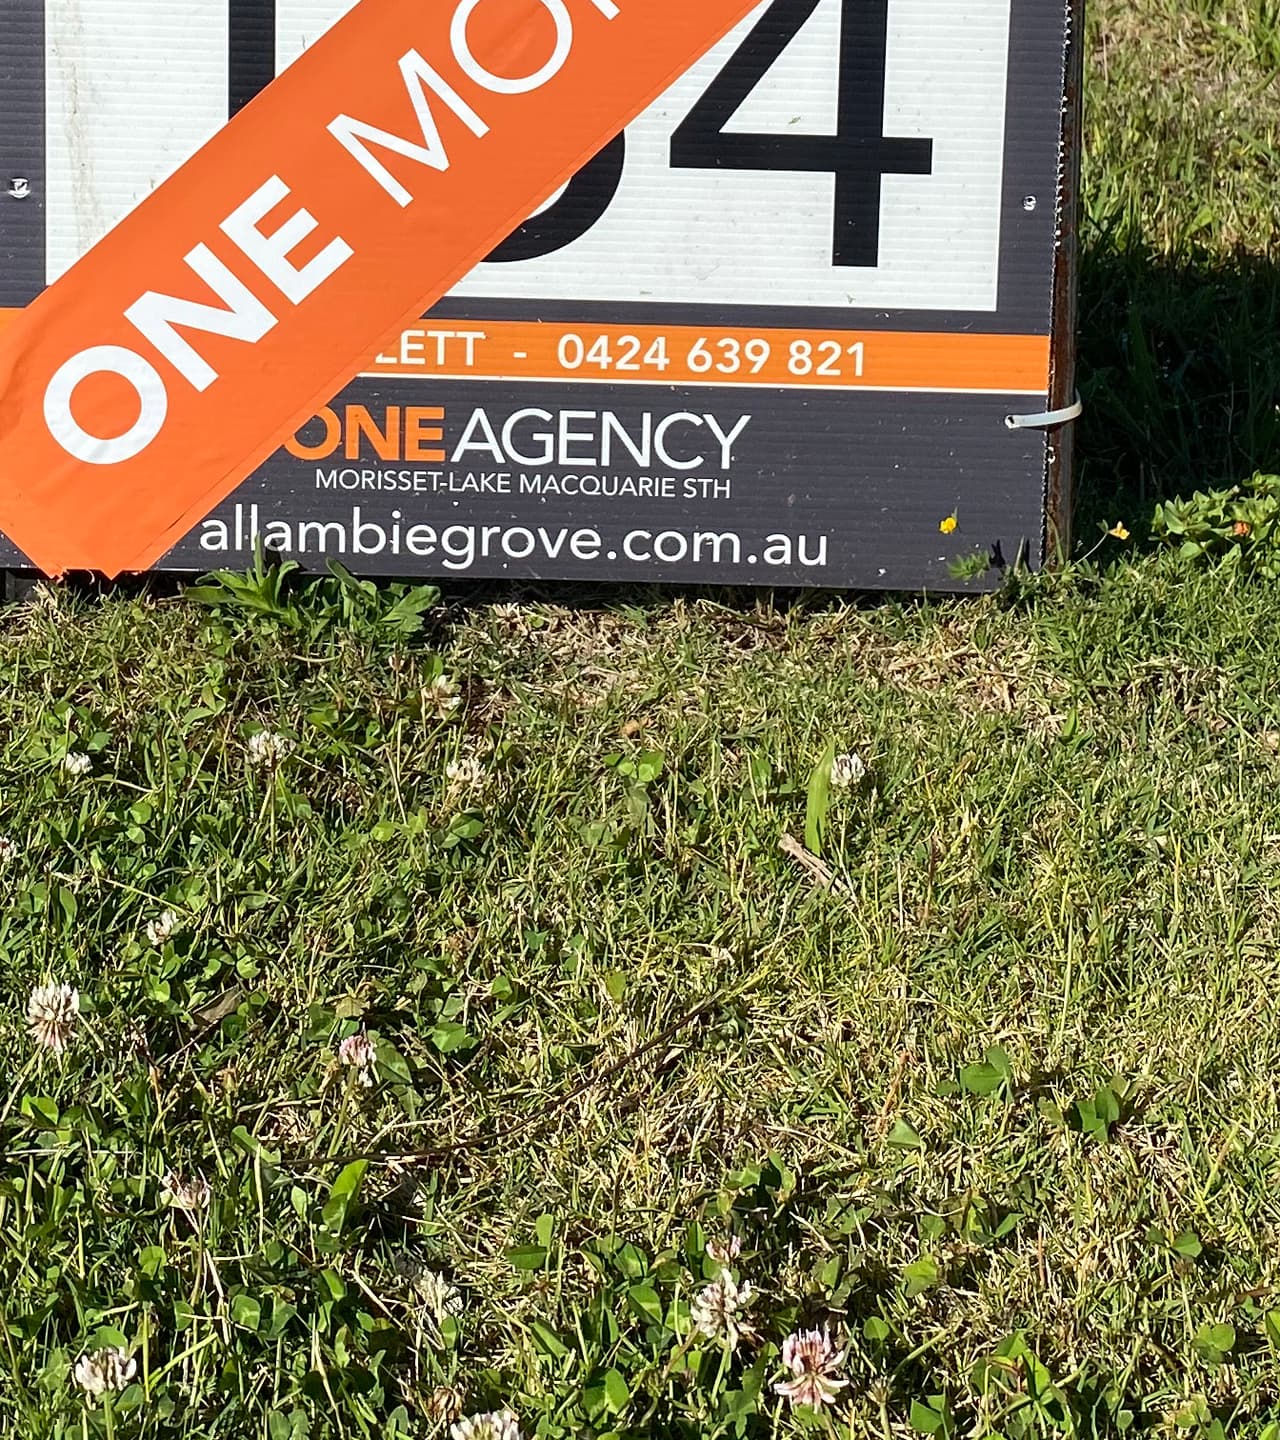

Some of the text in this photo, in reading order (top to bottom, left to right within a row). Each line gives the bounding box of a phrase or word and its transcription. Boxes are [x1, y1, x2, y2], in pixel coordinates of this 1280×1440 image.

[43, 174, 355, 465] ONE
[557, 333, 670, 371] 0424
[687, 337, 771, 374] 639
[787, 339, 865, 377] 821
[315, 468, 731, 499] MORISSET-LAKE MACQUARIE STH
[199, 503, 828, 570] allambiegrove.com.au
